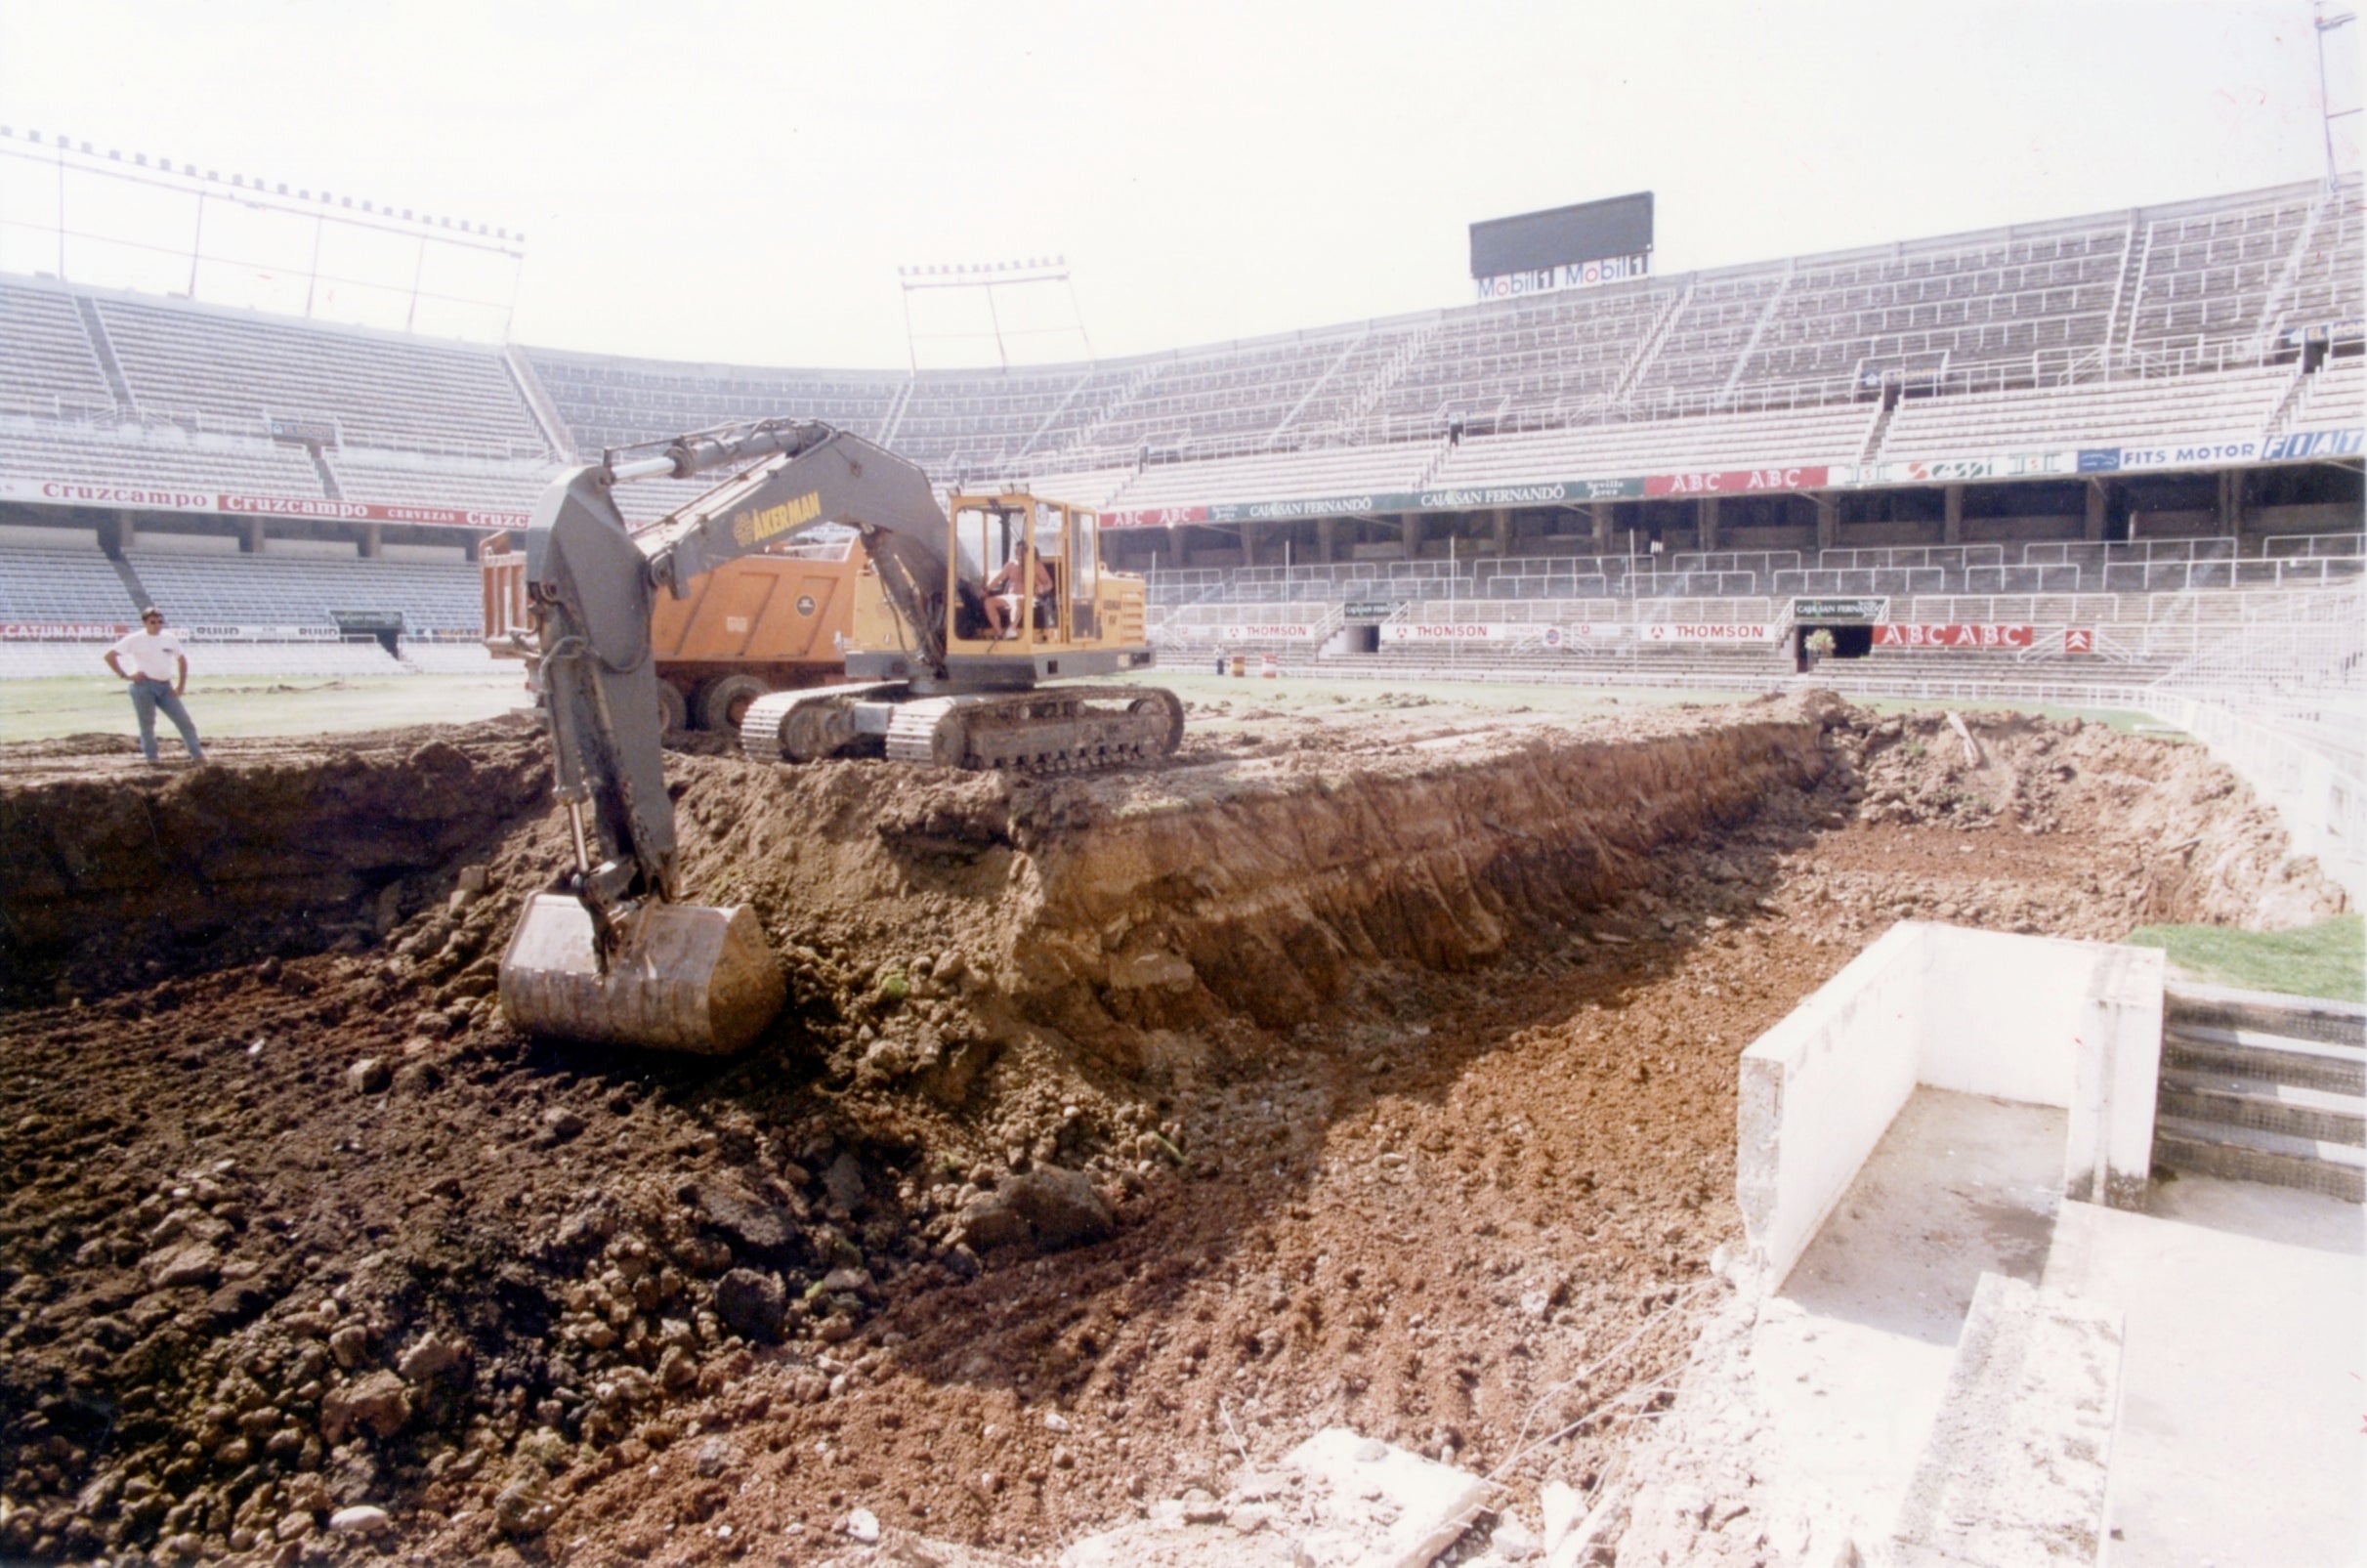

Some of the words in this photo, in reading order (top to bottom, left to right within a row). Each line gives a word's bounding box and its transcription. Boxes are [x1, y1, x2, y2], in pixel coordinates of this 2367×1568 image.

[1565, 255, 1628, 285] Mobil
[1478, 273, 1535, 299] Mobil
[2261, 429, 2365, 460] FIAT
[2124, 448, 2166, 465] FITS
[2176, 444, 2255, 462] MOTOR
[1670, 473, 1720, 492] ABC
[1748, 468, 1801, 488] ABC
[43, 483, 207, 508] Cruzcampo
[1456, 489, 1482, 505] SAN
[227, 495, 368, 518] Cruzcampo
[388, 509, 455, 522] CERVEZAS
[1160, 507, 1192, 525] ABC
[1279, 502, 1302, 516] SAN
[1114, 511, 1144, 526] ABC
[1247, 626, 1307, 636] THOMSON
[1417, 625, 1488, 636] THOMSON
[1675, 625, 1764, 638] THOMSON
[1881, 624, 1947, 645] ABC
[1956, 624, 2023, 645] ABC
